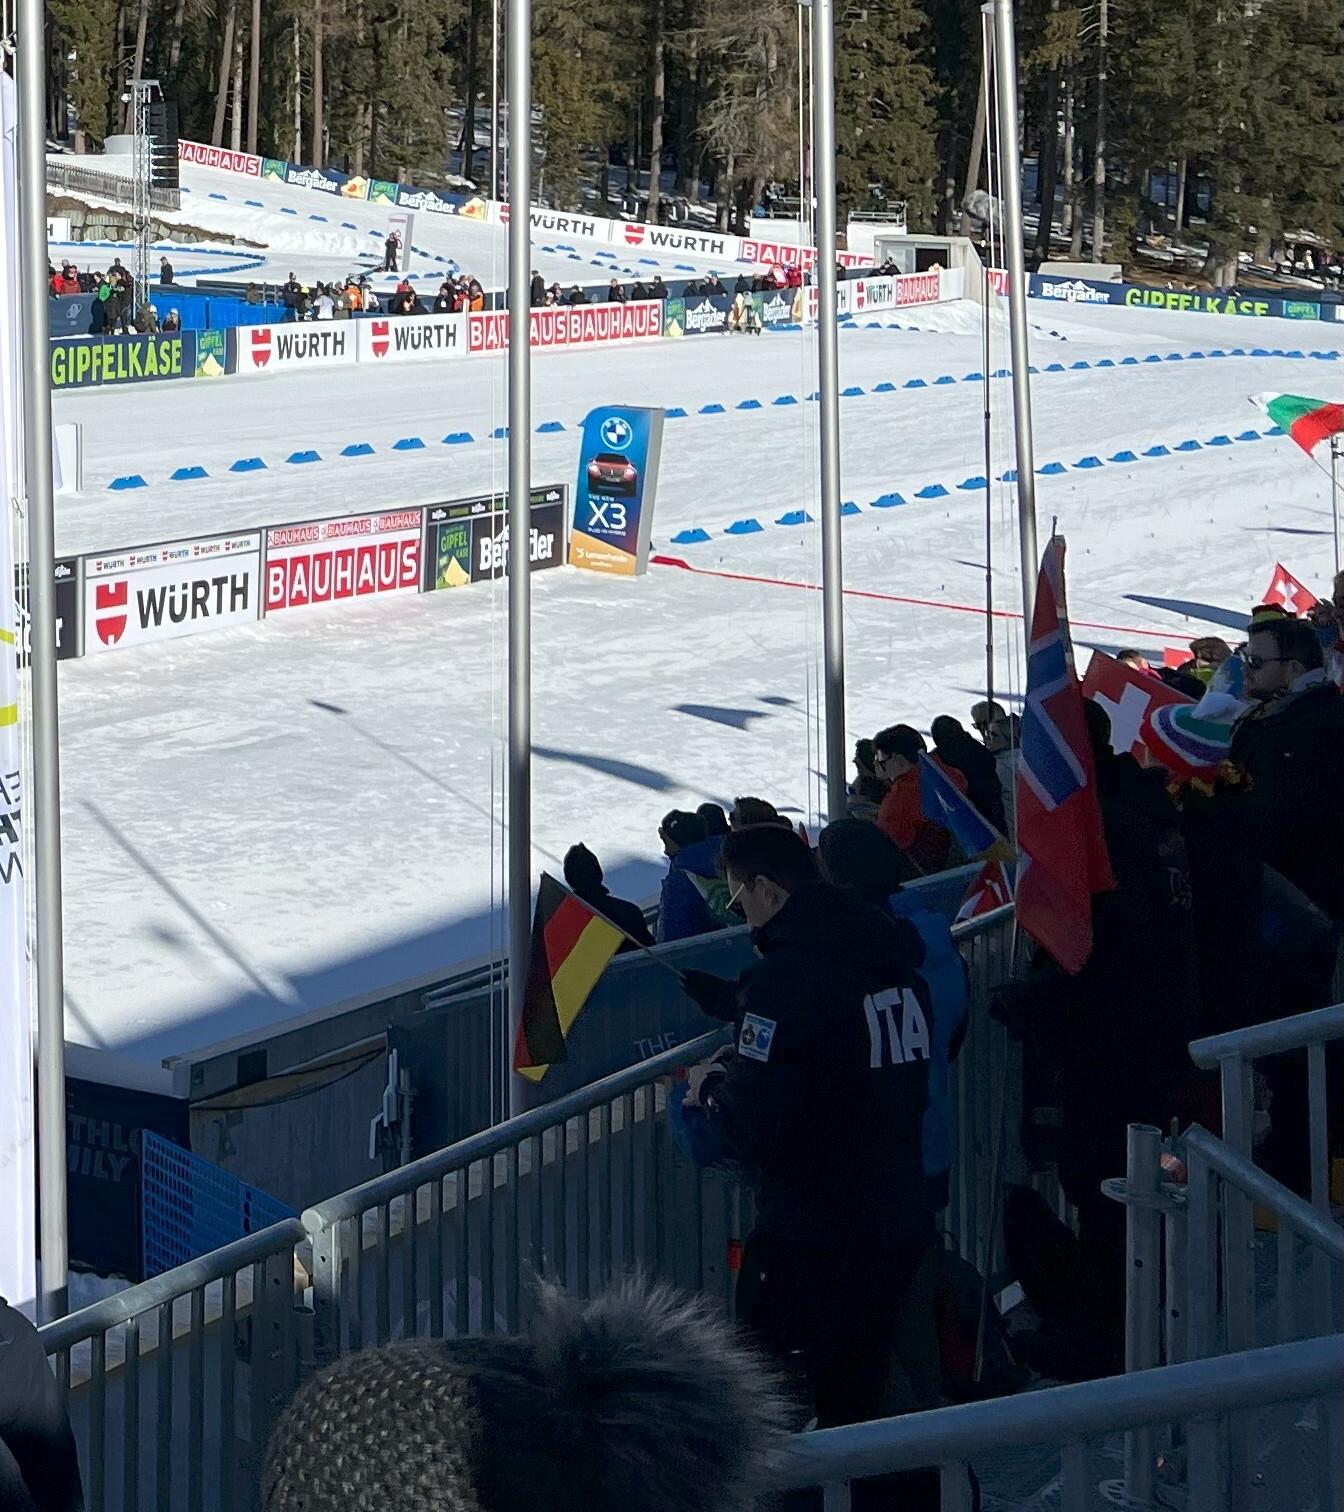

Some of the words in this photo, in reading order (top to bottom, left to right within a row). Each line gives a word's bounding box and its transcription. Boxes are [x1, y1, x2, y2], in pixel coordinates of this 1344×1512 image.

[288, 169, 338, 192] Bergader
[400, 192, 455, 215] Bergader
[650, 230, 724, 255] WÜRTH
[897, 277, 939, 304] BAUHAUS
[1042, 282, 1110, 303] Bergader
[571, 306, 659, 341] BAUHAUS
[685, 308, 728, 330] Bergader
[277, 331, 345, 359] WÜRTH
[394, 324, 457, 351] WÜRTH
[51, 337, 182, 385] GIPFELKÄSE
[328, 519, 370, 538] BAUHAUS
[379, 512, 420, 531] BAUHAUS
[588, 501, 627, 530] X3
[274, 526, 319, 546] BAUHAUS
[441, 532, 468, 552] GIPFEL
[480, 528, 554, 571] Berder
[268, 545, 417, 604] BAUHAUS
[137, 572, 249, 629] WÜRTH
[863, 987, 931, 1068] ITA
